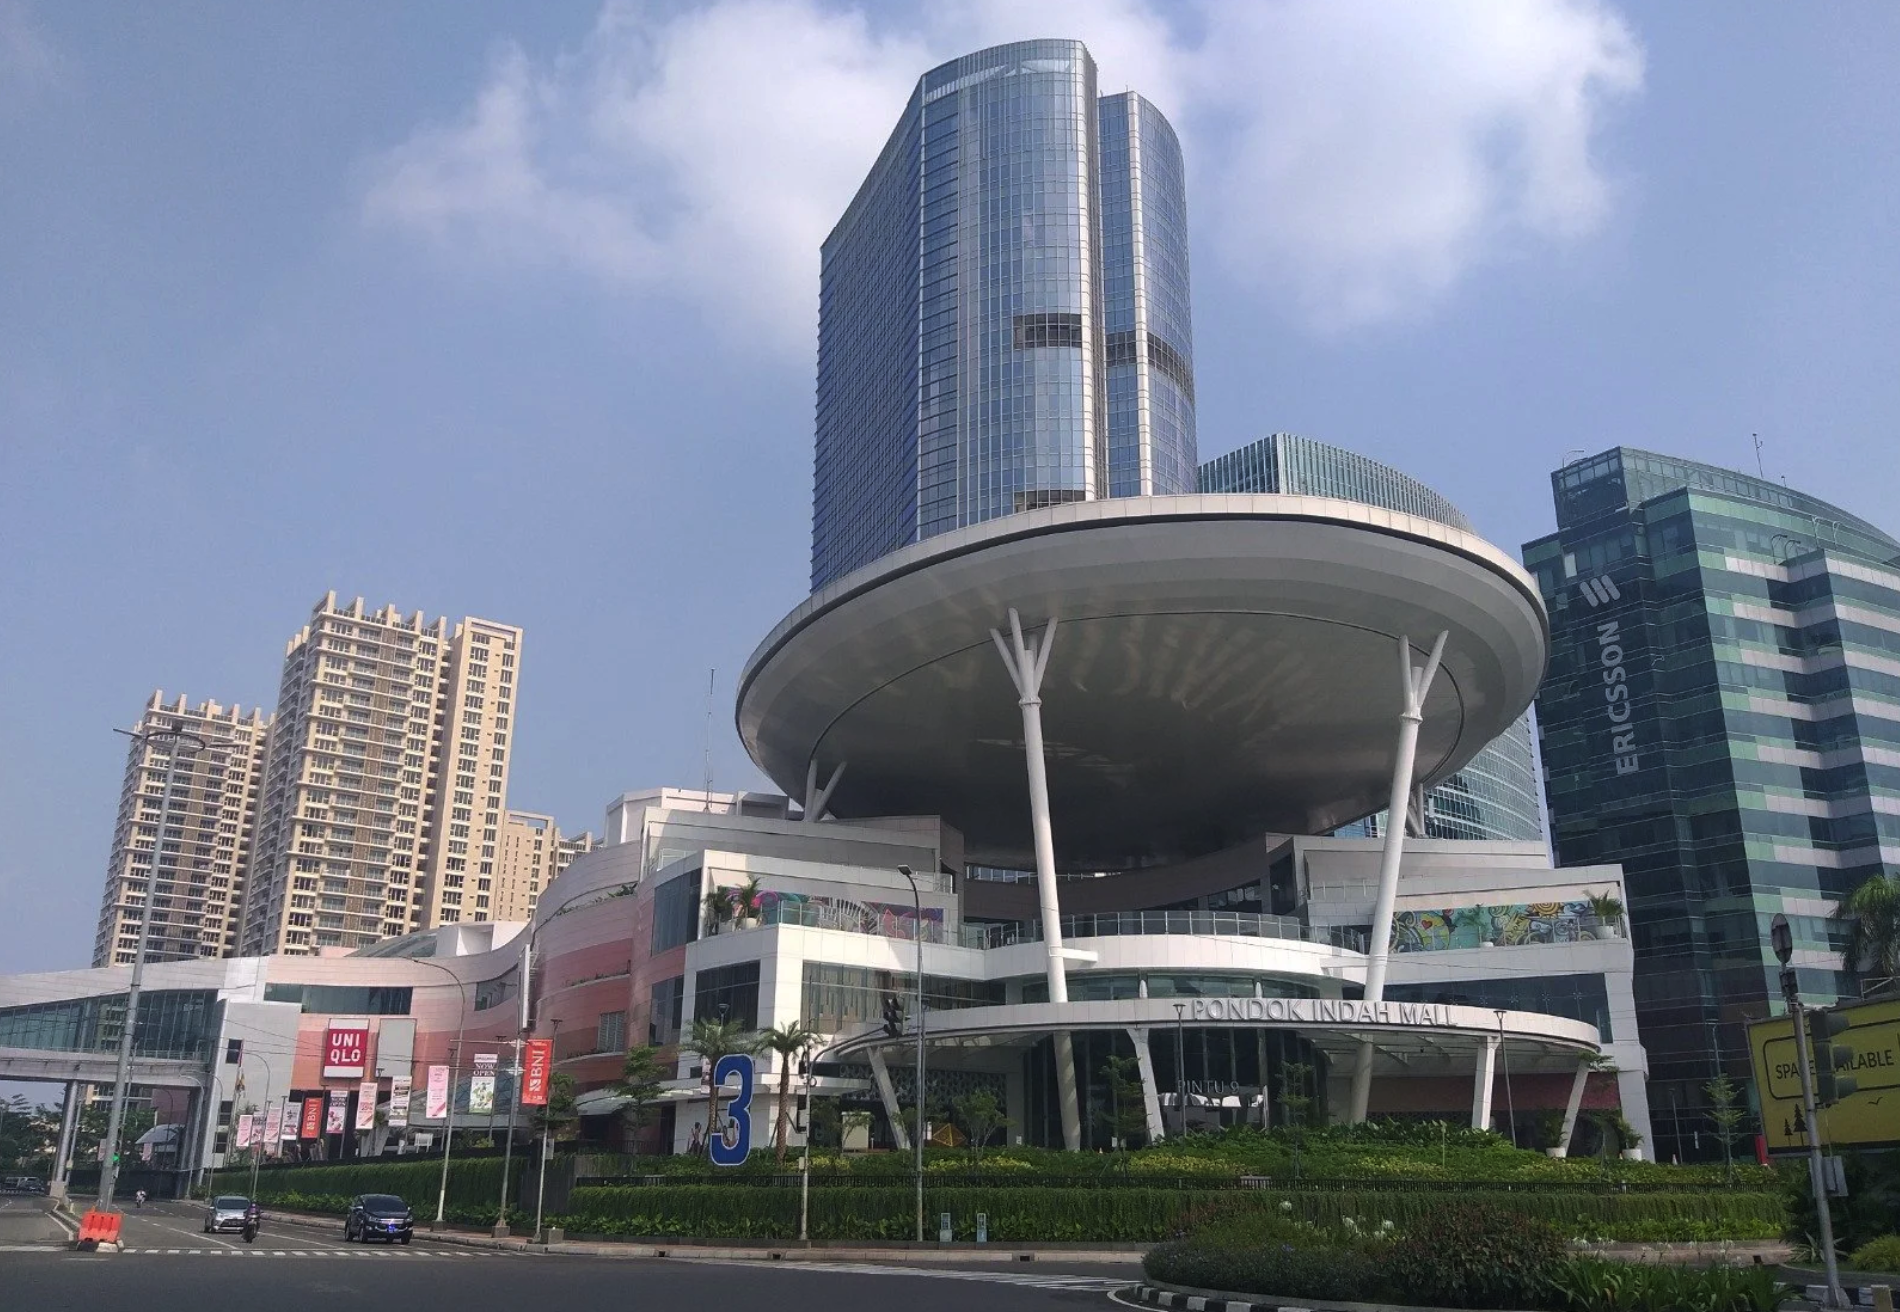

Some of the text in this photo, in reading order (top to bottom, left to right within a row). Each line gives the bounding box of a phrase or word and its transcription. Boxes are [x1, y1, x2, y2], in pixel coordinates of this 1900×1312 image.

[1597, 621, 1639, 775] ERICSSON
[1191, 999, 1458, 1026] PONDOK INDAH MALL
[332, 1033, 360, 1047] UNI
[330, 1048, 361, 1064] QLO
[530, 1050, 545, 1077] BNI
[1775, 1060, 1816, 1080] SPAE
[1230, 1080, 1239, 1095] 9
[308, 1104, 317, 1120] BNI
[710, 1054, 754, 1166] 3
